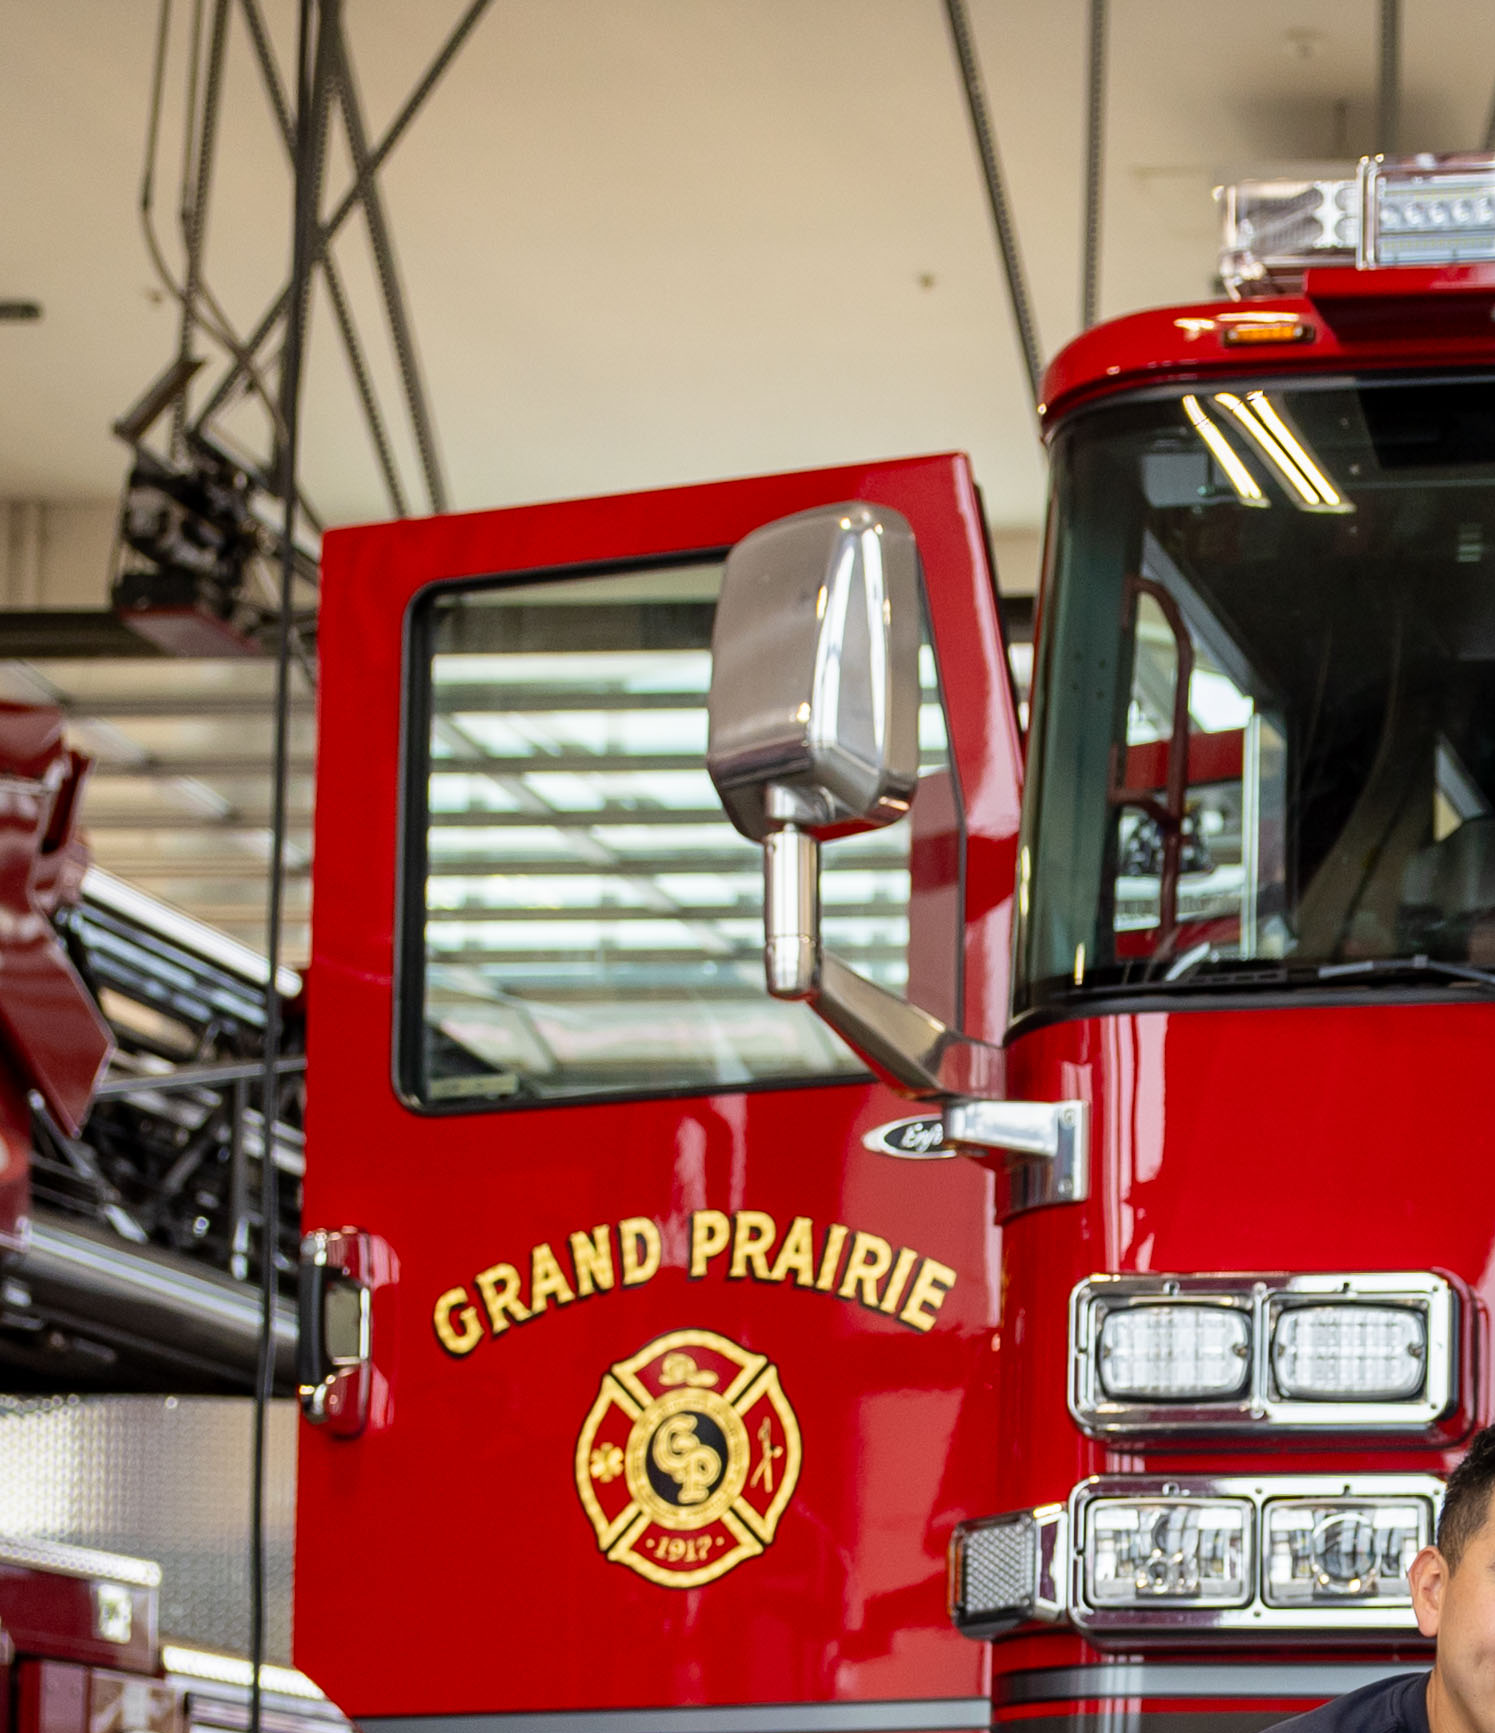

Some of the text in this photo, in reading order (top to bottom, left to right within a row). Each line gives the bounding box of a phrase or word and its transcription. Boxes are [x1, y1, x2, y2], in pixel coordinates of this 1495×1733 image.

[433, 1209, 957, 1358] GRAND PRAIRIE
[653, 1535, 713, 1562] 1917
